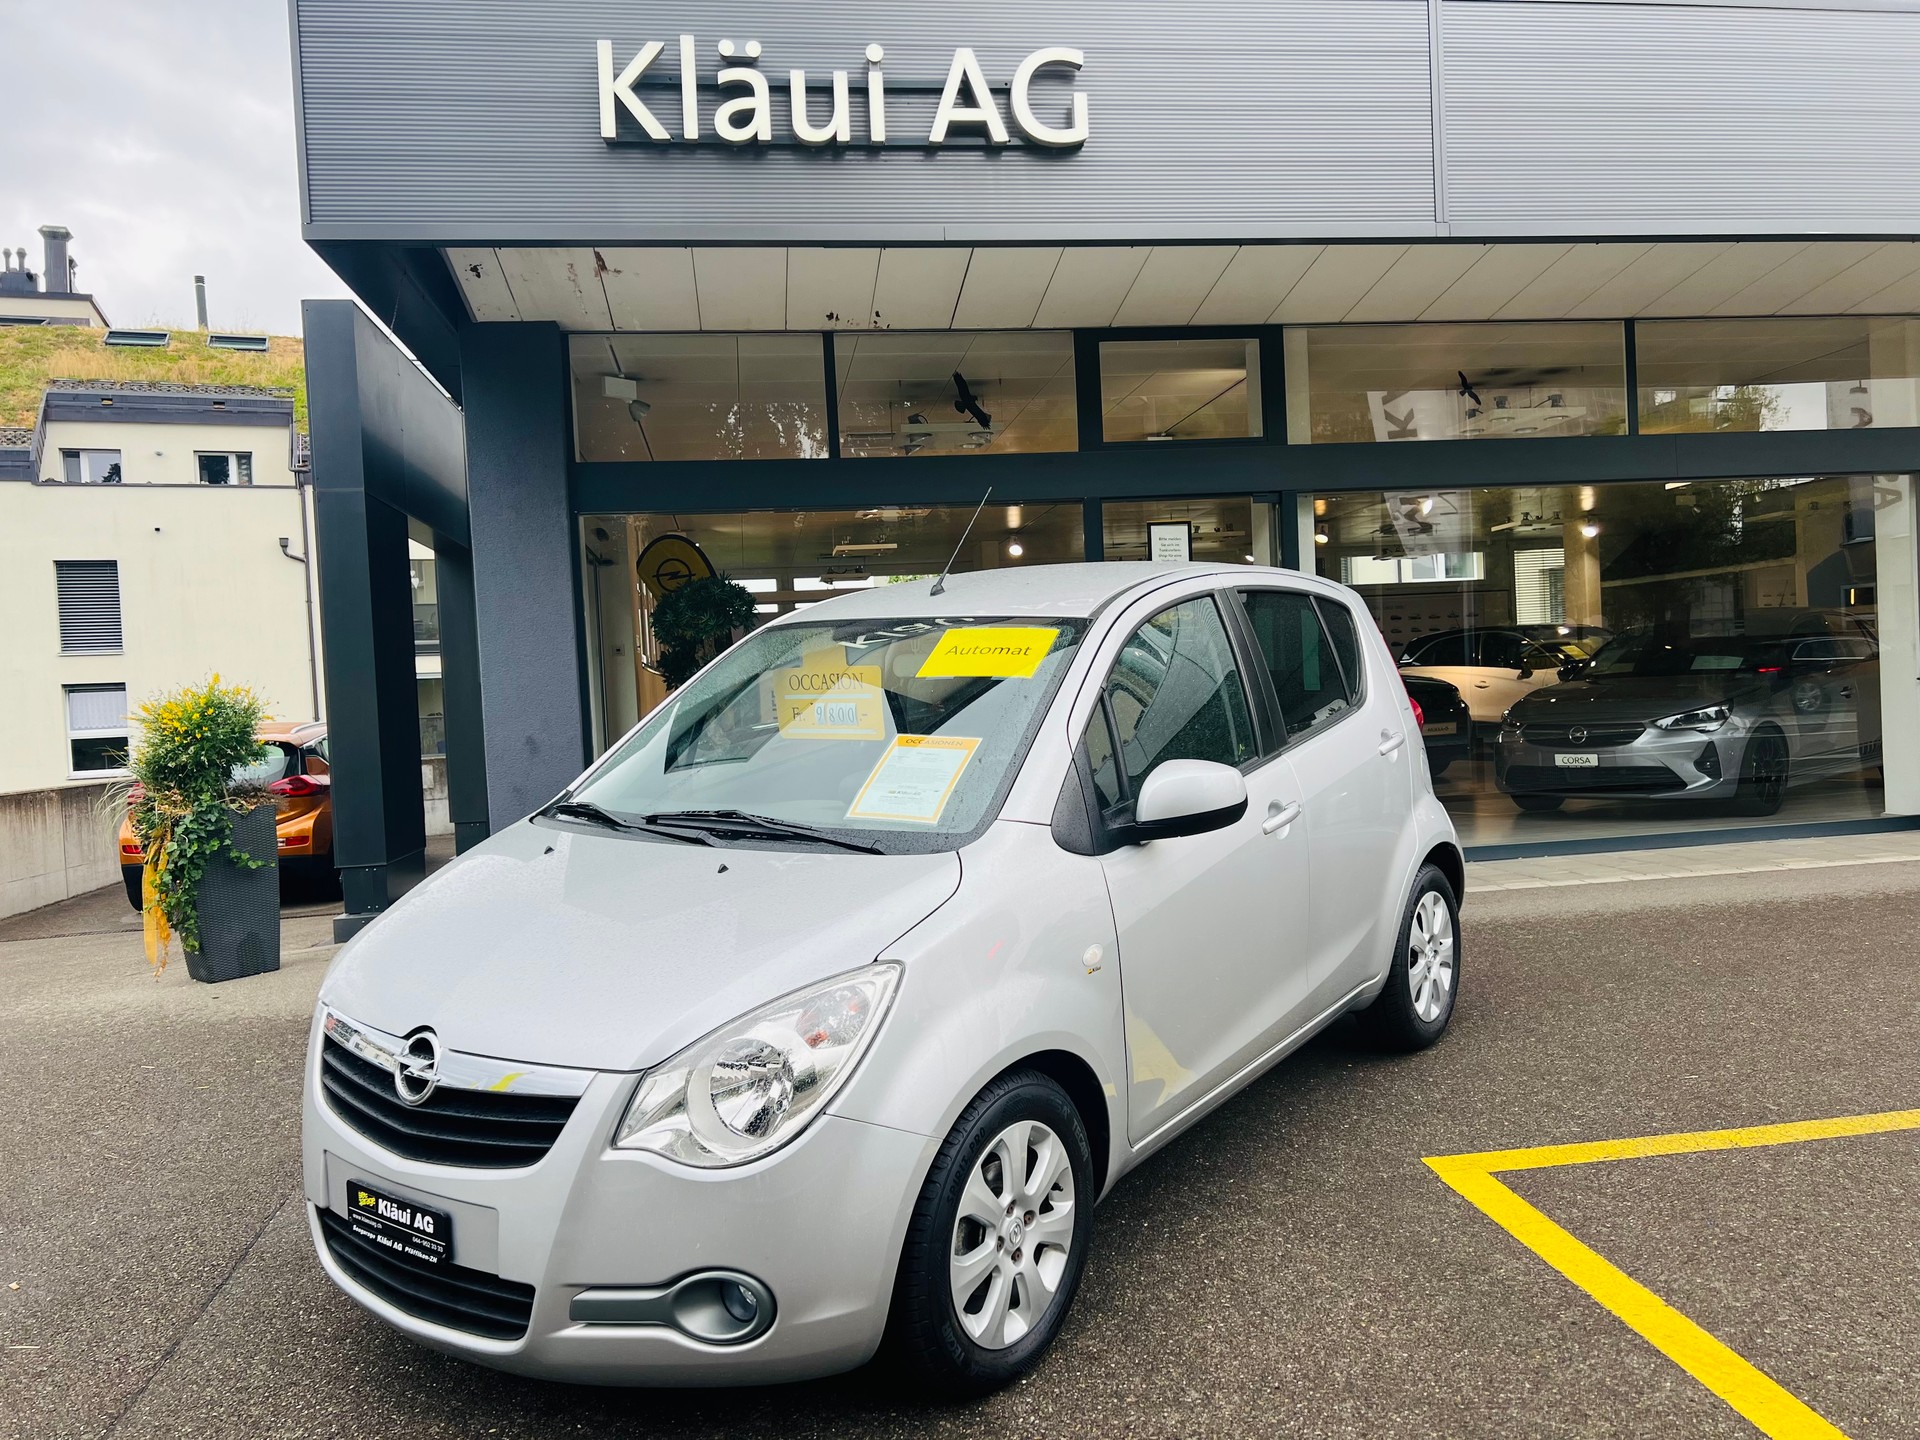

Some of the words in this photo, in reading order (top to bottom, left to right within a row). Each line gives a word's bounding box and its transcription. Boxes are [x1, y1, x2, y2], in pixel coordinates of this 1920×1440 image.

[596, 34, 886, 145] Kläui
[929, 46, 1090, 147] AG
[945, 645, 1032, 656] Automat
[789, 673, 864, 691] OCCASION
[905, 738, 963, 747] OCCASIONEN
[378, 1198, 411, 1225] Kläui
[413, 1212, 434, 1234] AG
[392, 1241, 403, 1252] AG
